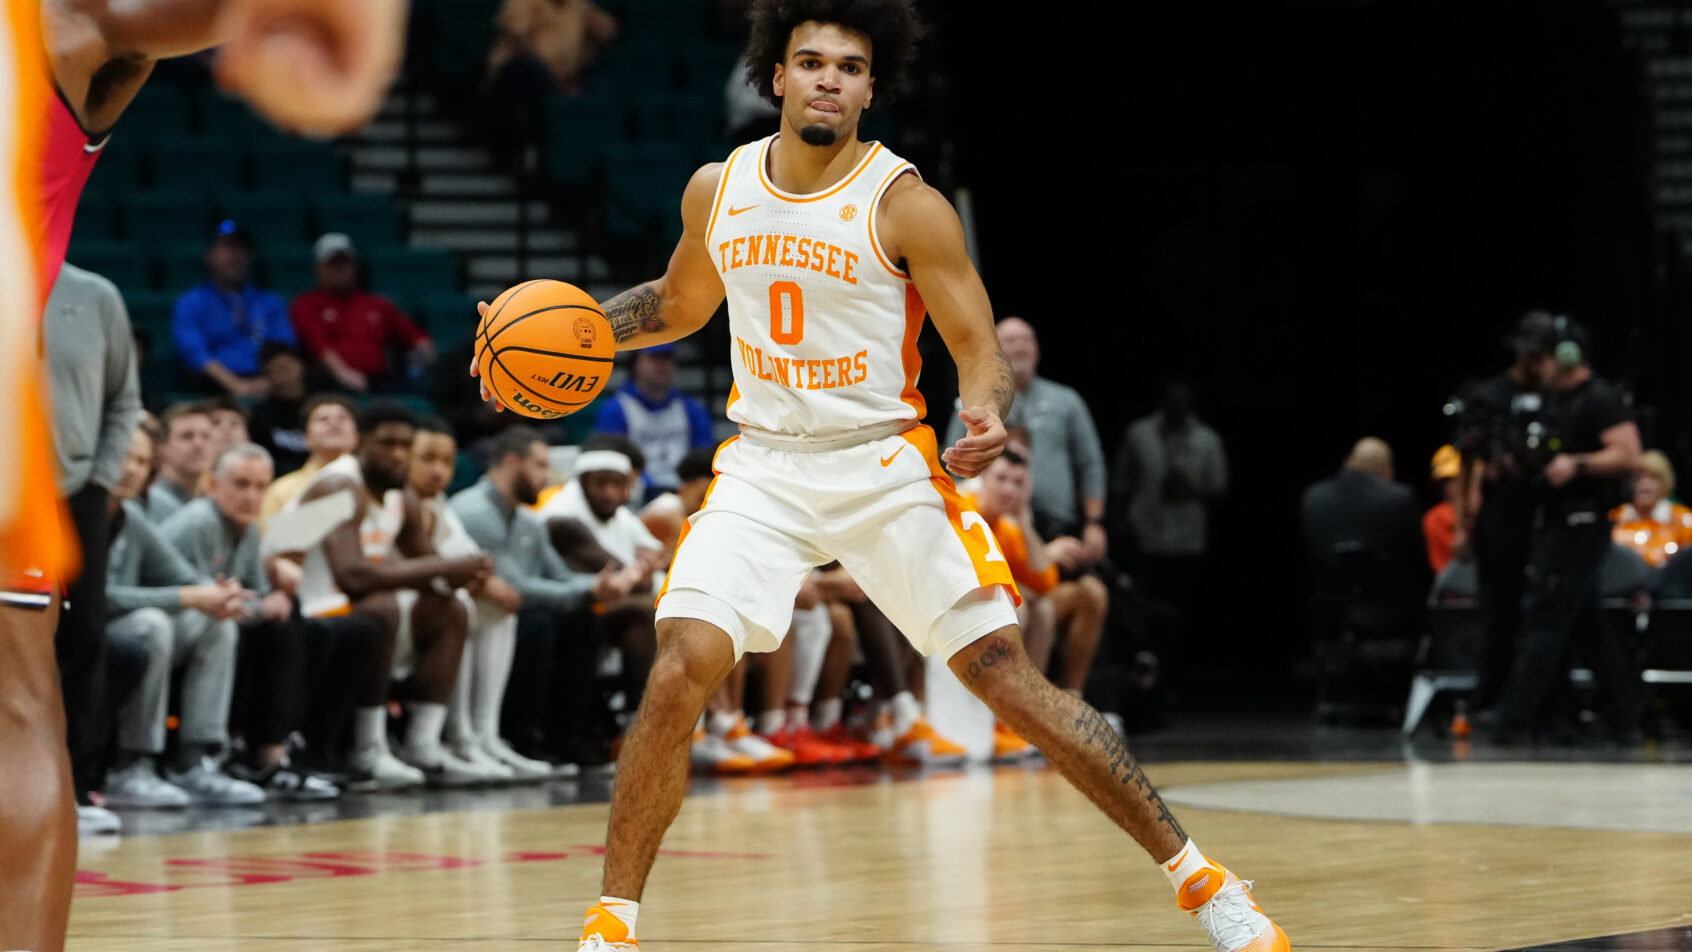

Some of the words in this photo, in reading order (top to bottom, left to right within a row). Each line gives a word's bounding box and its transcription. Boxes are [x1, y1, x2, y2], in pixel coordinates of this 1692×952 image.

[719, 235, 859, 285] TENNESSEE
[769, 281, 804, 345] 0
[530, 374, 549, 385] NXT
[550, 371, 600, 392] EVO
[737, 336, 868, 390] VOLNTEERS
